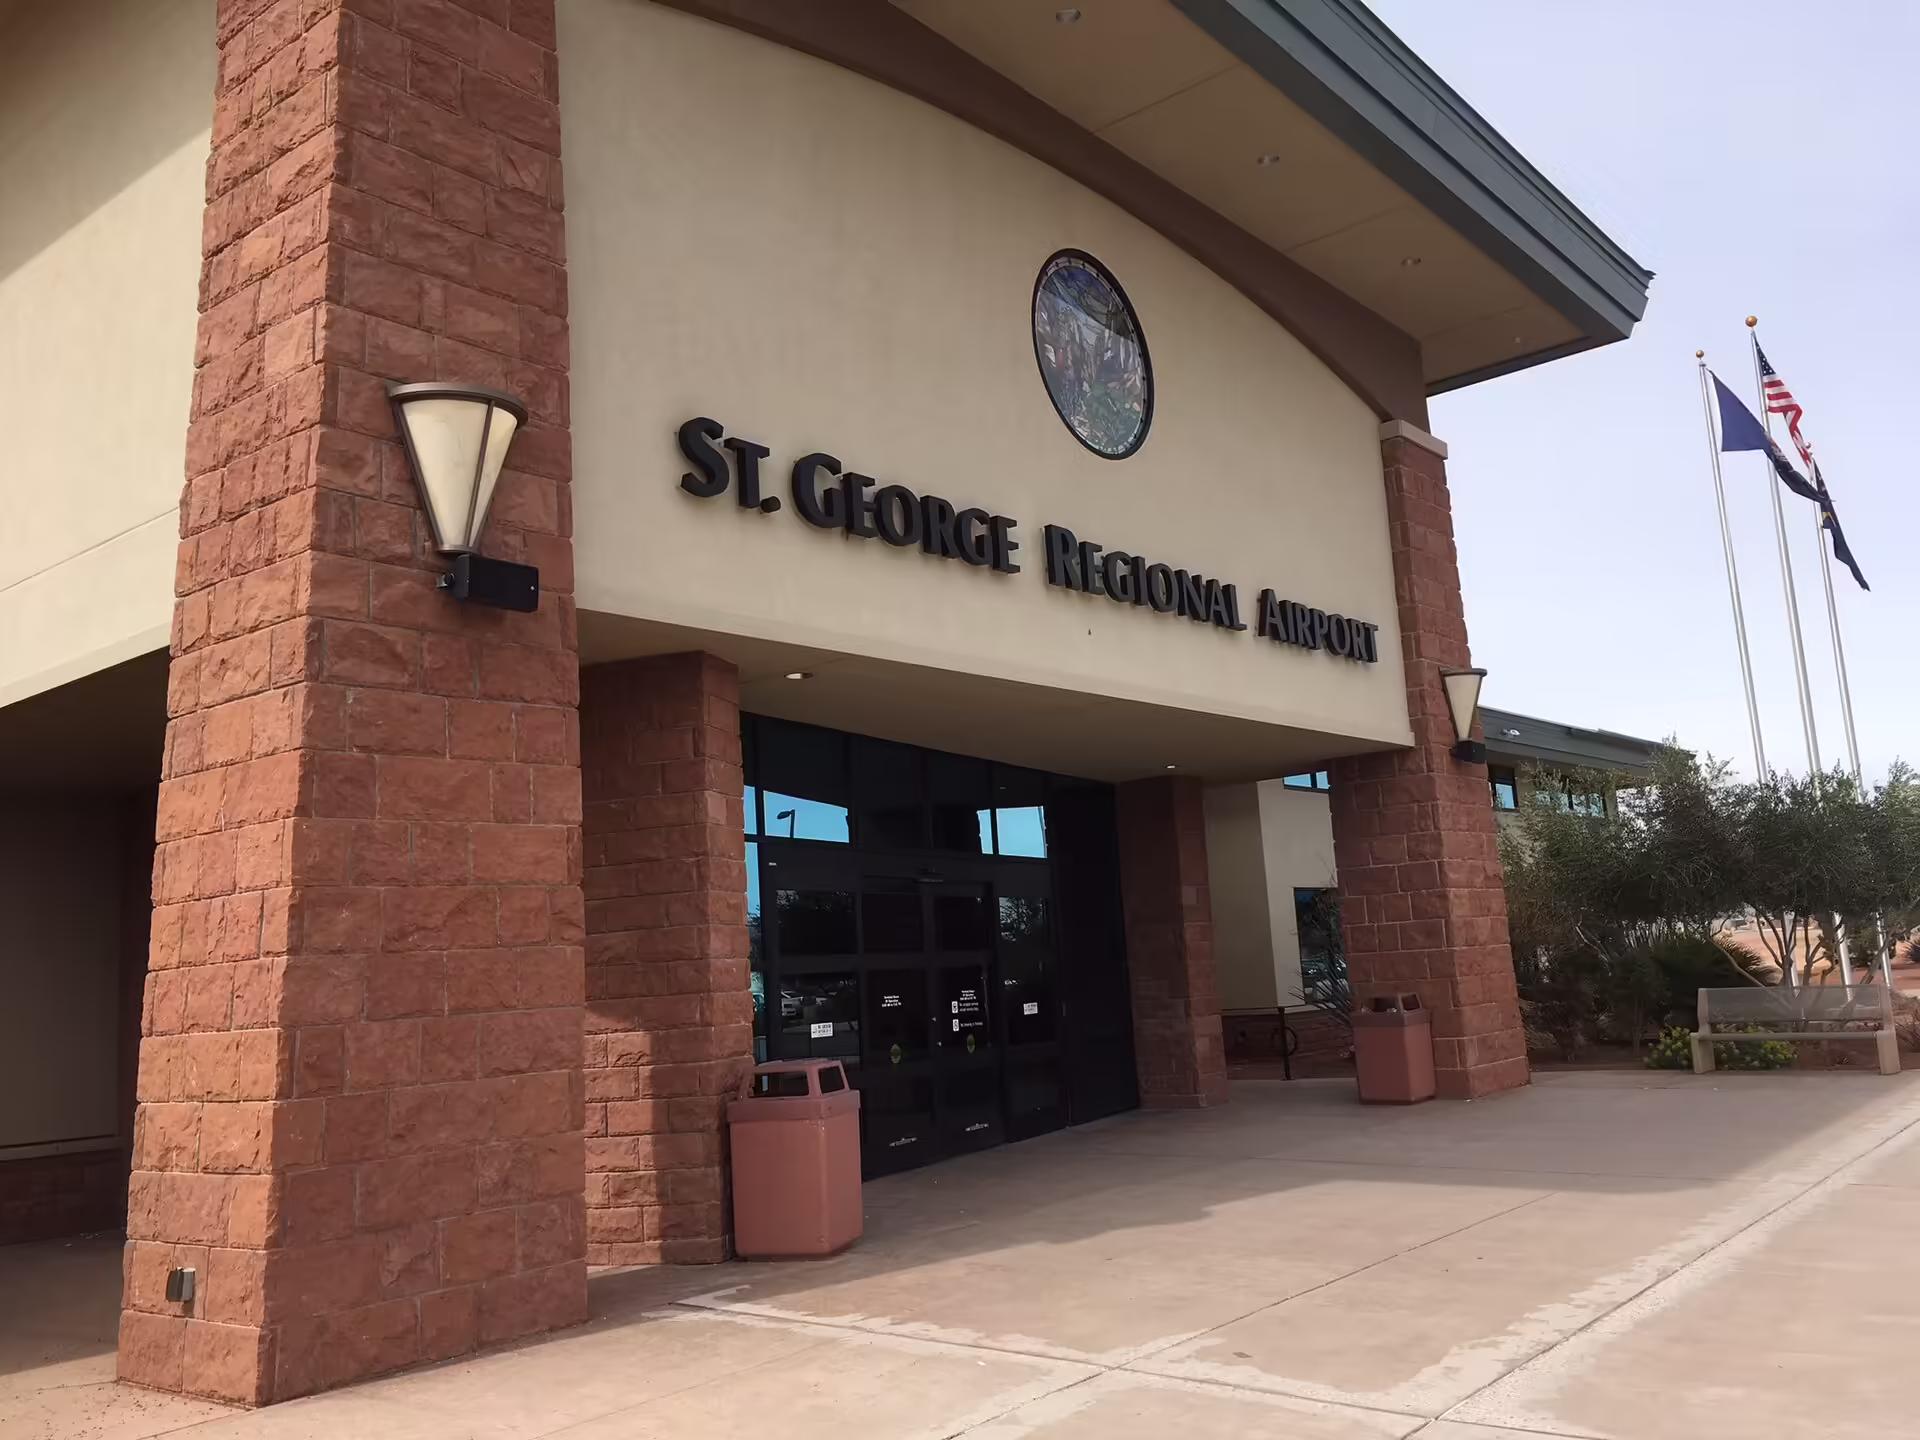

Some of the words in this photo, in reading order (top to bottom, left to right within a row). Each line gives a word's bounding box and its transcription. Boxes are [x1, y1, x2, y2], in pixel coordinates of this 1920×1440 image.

[677, 416, 782, 513] ST.
[792, 453, 1021, 575] GEORGE
[1043, 523, 1248, 632] REGIONAL
[1256, 587, 1379, 664] AIRPORT
